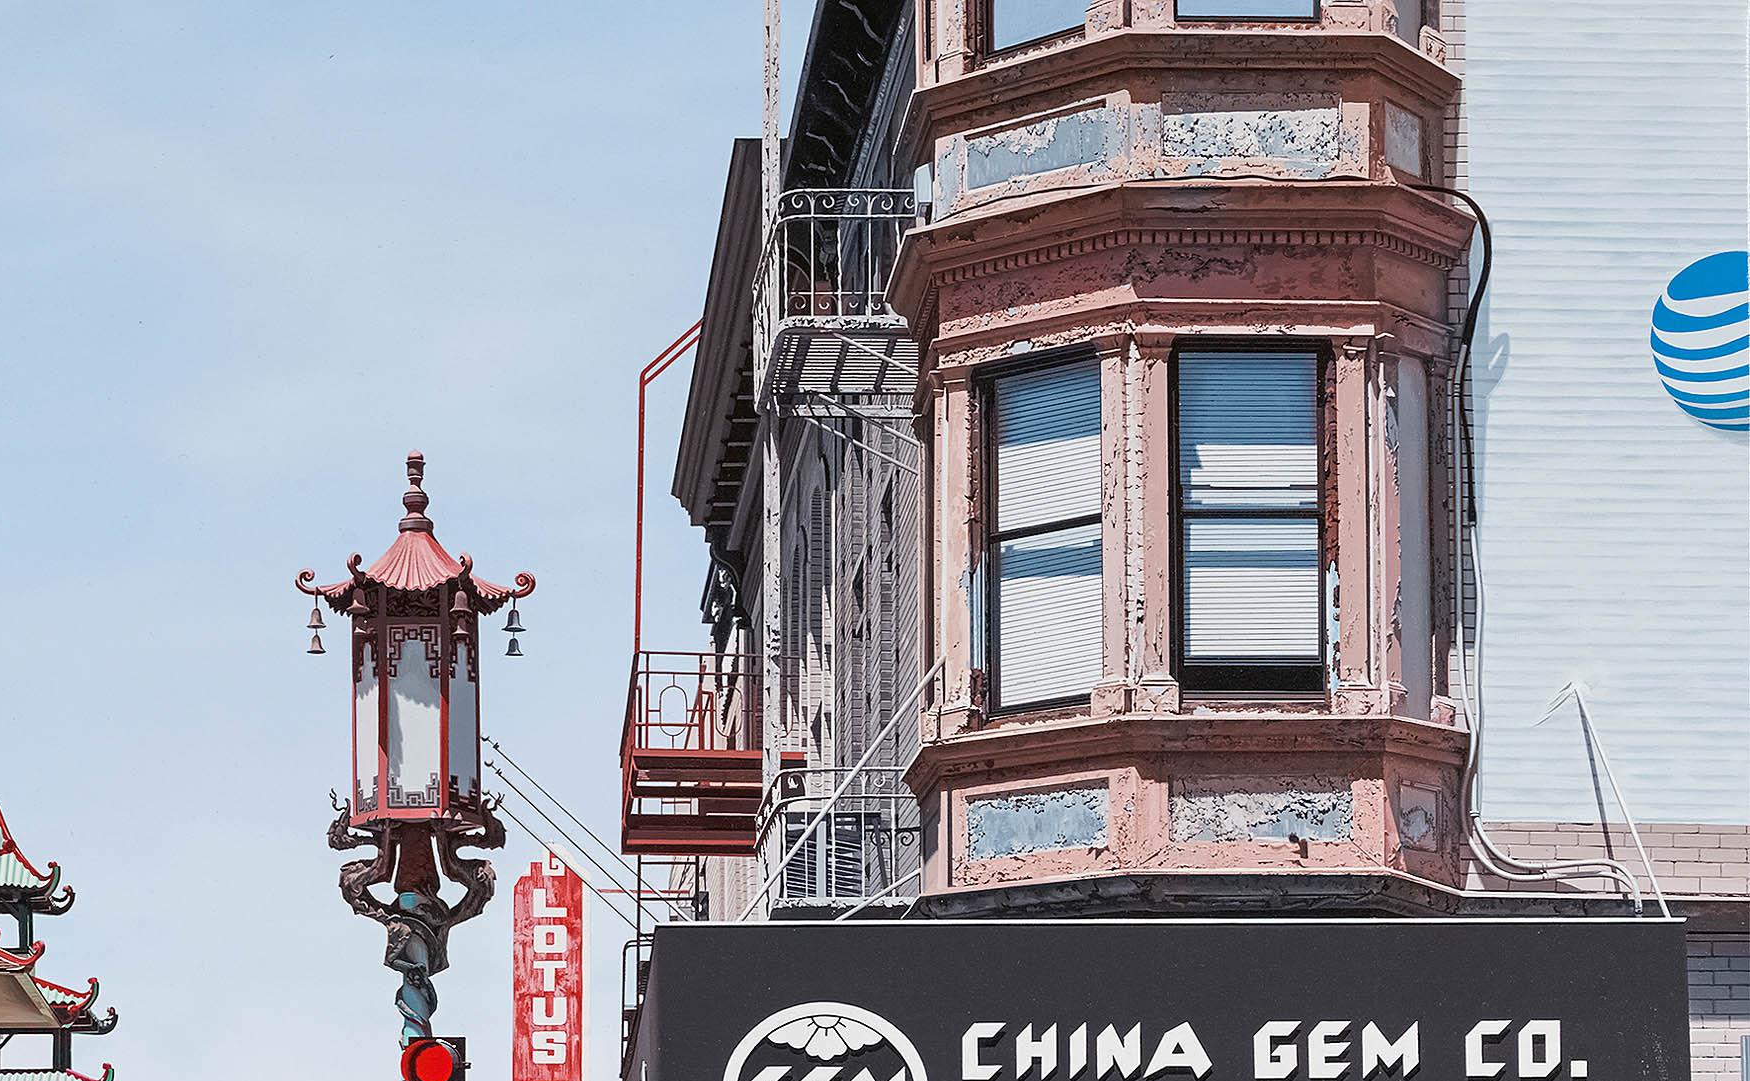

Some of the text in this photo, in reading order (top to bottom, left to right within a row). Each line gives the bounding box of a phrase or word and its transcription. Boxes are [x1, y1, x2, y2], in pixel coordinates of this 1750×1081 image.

[532, 888, 567, 1064] LOTUS
[961, 1019, 1588, 1081] CHINA GEM CO.
